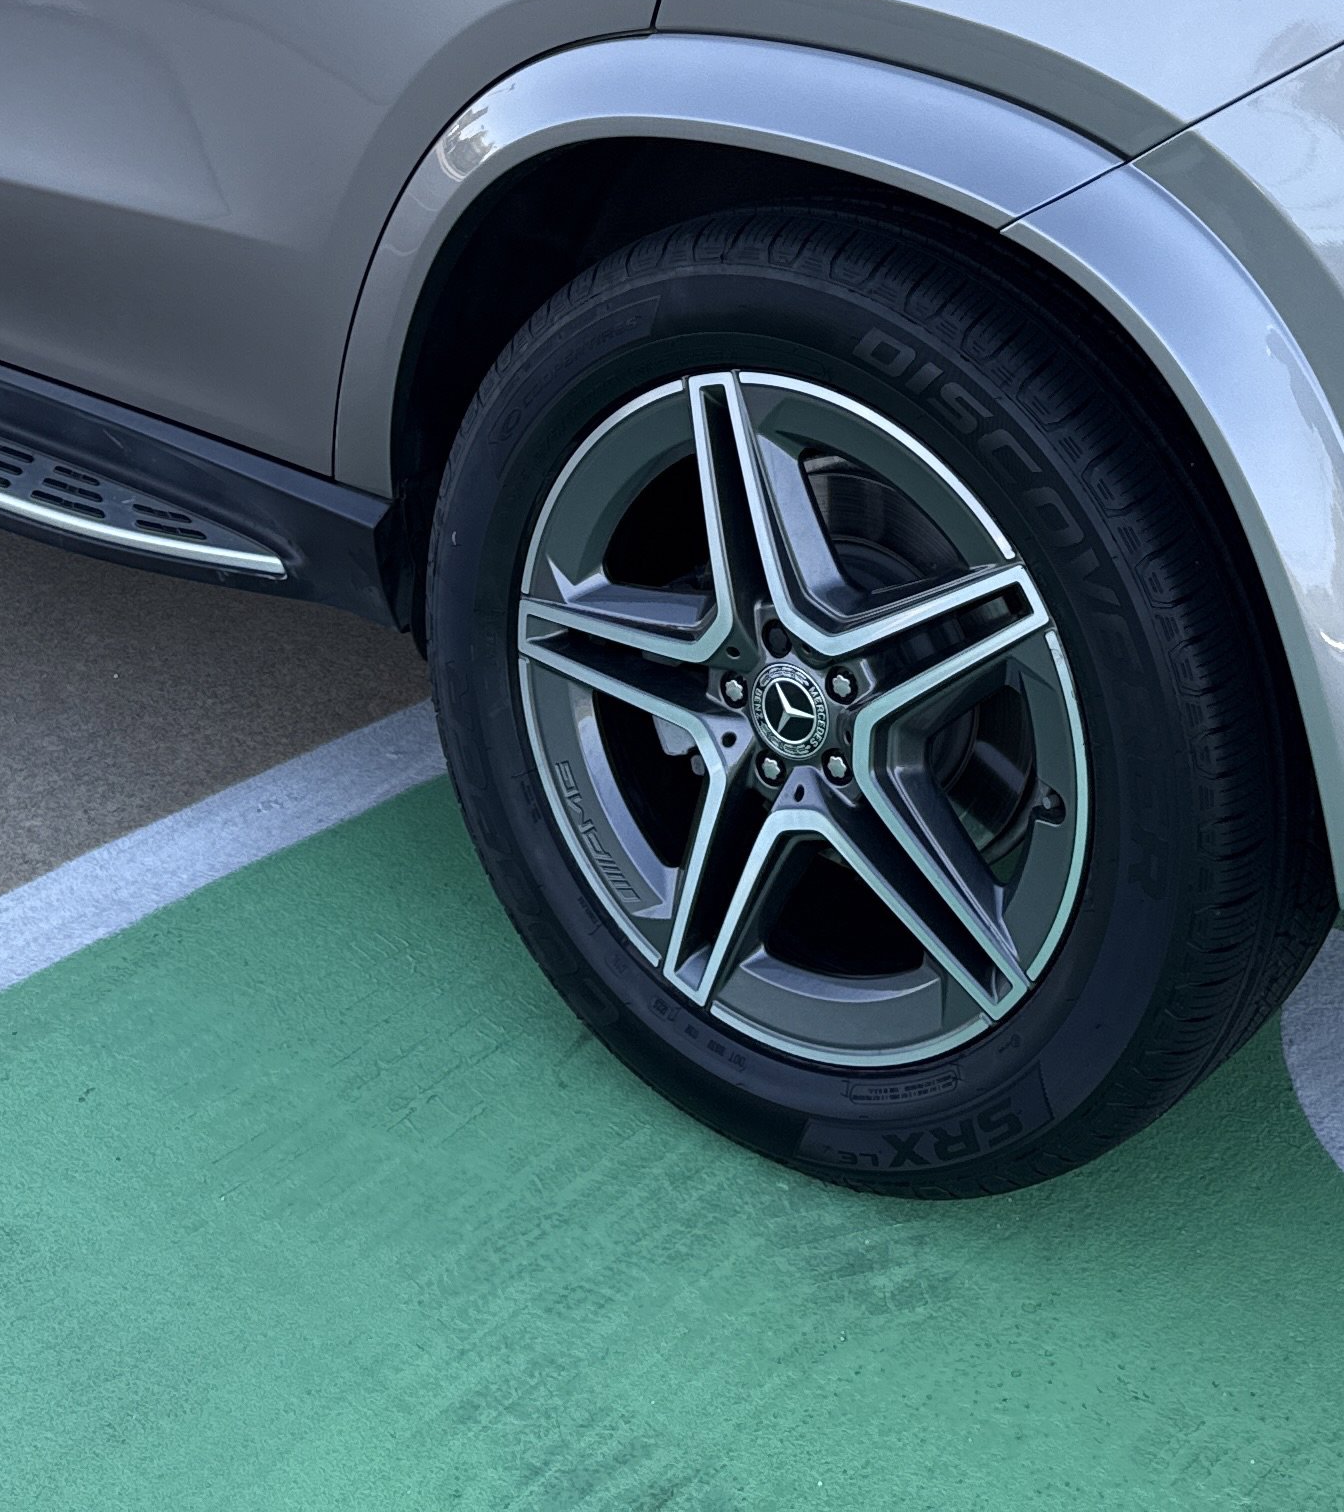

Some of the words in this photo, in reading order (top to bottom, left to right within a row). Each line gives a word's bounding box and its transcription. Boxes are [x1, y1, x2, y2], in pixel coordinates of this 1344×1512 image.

[754, 687, 763, 720] BENZ
[809, 686, 826, 748] MERCEDES
[882, 1096, 1024, 1168] SRX
[837, 1149, 880, 1167] LE
